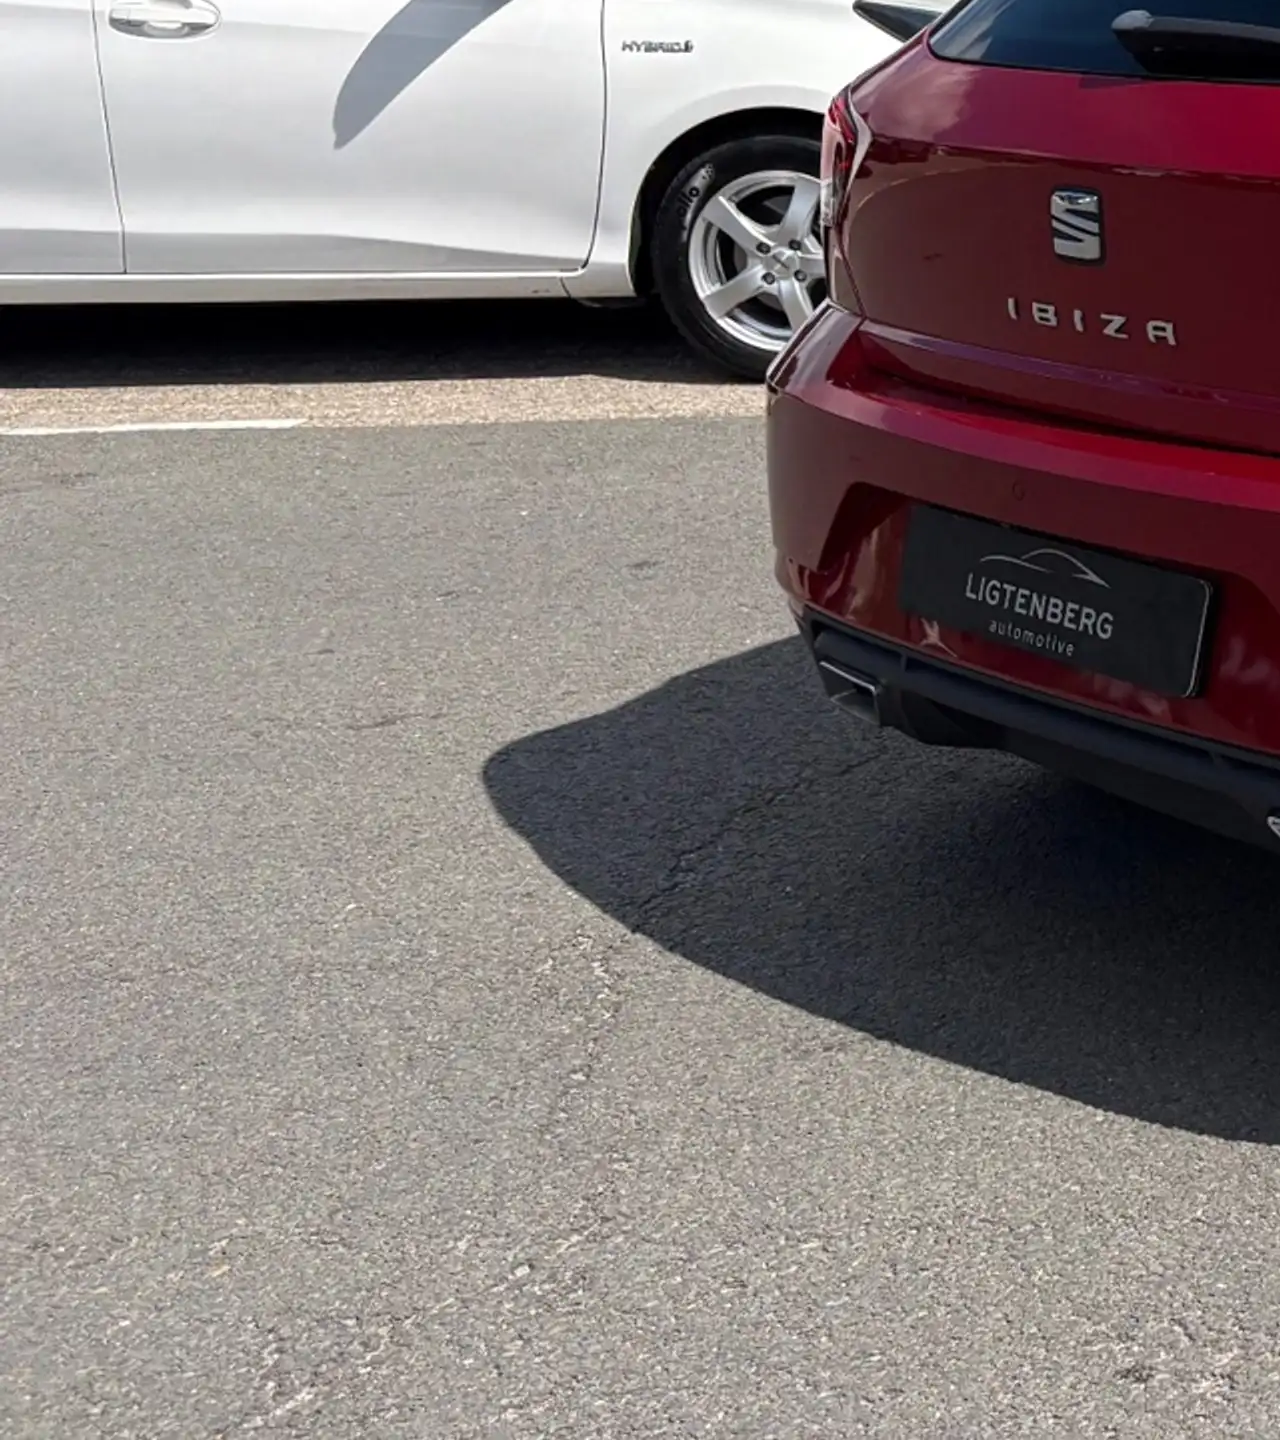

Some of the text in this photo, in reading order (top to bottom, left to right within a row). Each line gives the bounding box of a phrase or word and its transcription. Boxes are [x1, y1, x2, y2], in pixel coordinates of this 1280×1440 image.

[1007, 297, 1176, 346] IBIZA
[965, 572, 1114, 640] LIGTENBERG
[989, 619, 1075, 657] automotive
